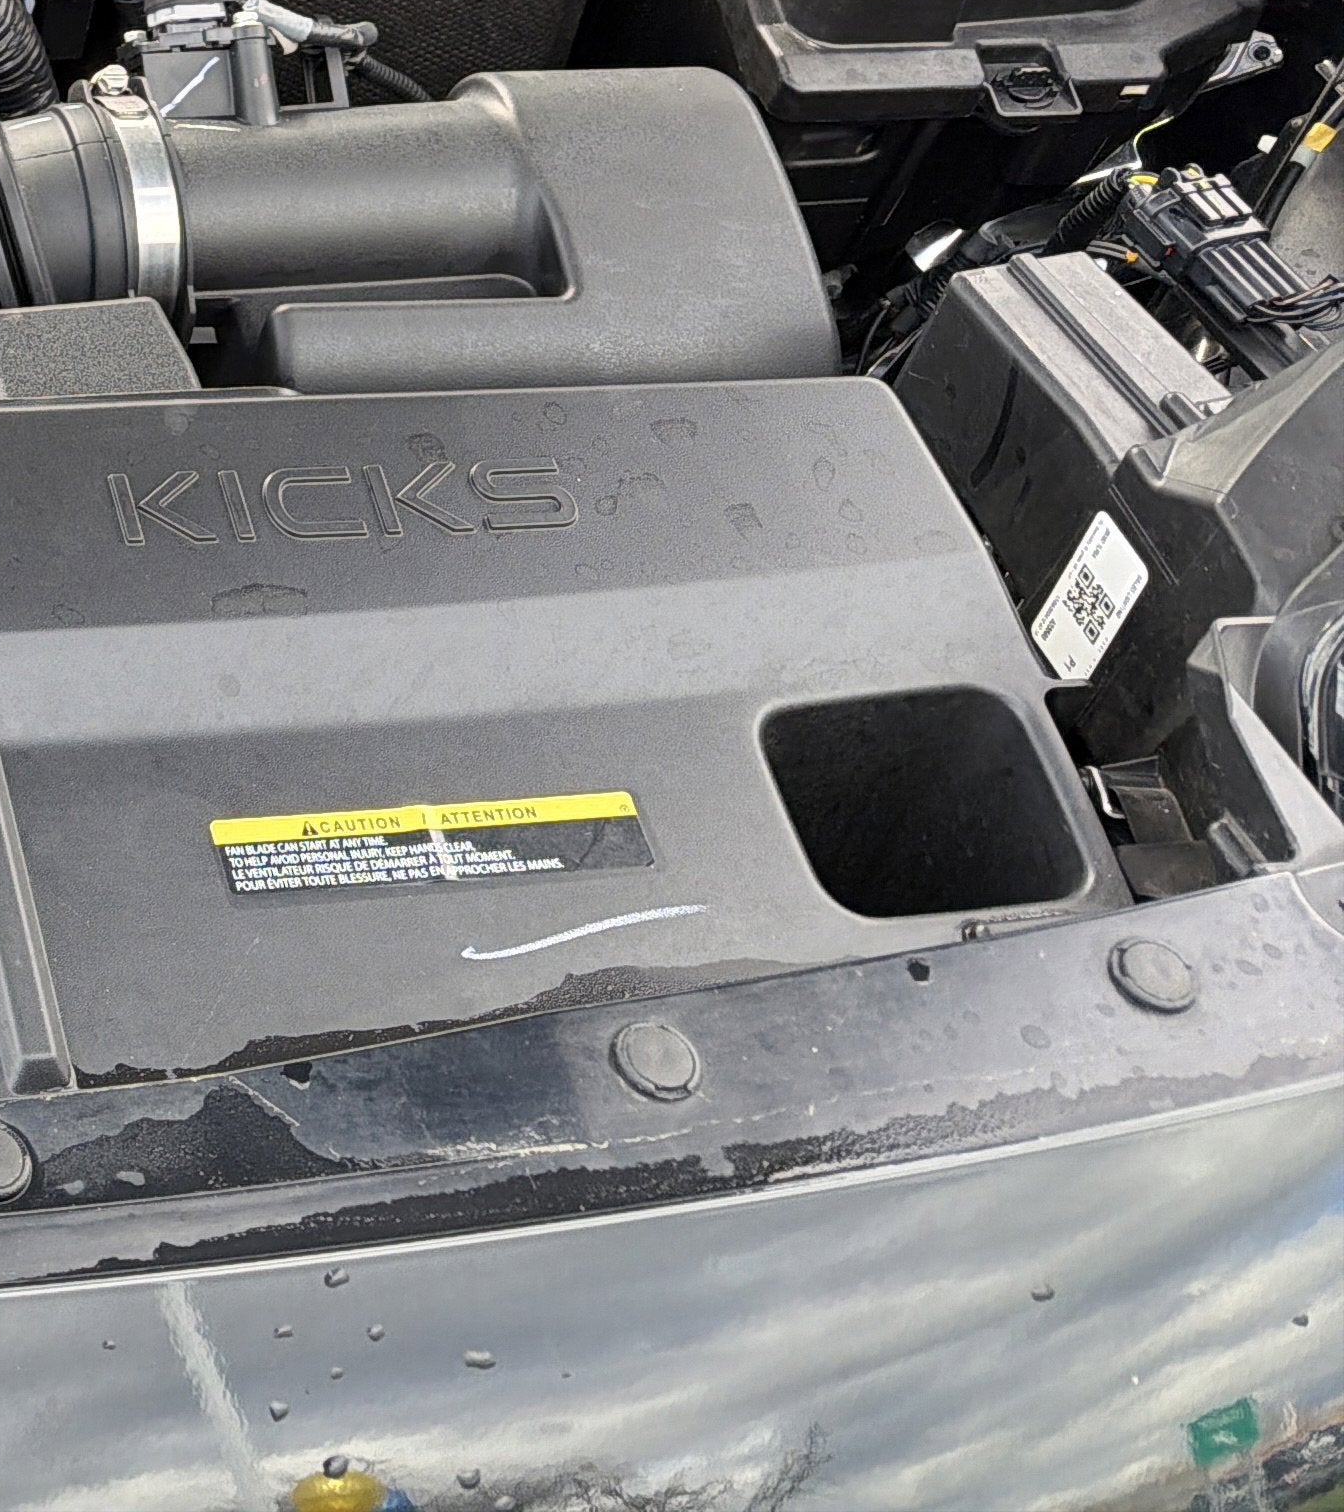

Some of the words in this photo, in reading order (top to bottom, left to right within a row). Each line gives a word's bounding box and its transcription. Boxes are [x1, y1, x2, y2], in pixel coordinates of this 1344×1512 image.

[107, 456, 580, 547] KICKS
[319, 816, 401, 833] CAUTION
[441, 806, 537, 825] ATTENTION
[225, 846, 245, 856] FAN
[245, 843, 277, 856] BLADE
[279, 842, 298, 853] CAN
[300, 840, 326, 852] START
[330, 839, 340, 849] AT
[343, 838, 361, 848] ANY
[228, 857, 243, 868] TO
[245, 856, 268, 867] HELP
[271, 853, 299, 865] AVOID
[301, 849, 350, 864] PERSONAL
[386, 846, 408, 857] KEEP
[232, 868, 246, 880] LE
[247, 864, 315, 879] VENTILATEUR
[316, 861, 352, 874] RISQUE
[355, 861, 369, 871] DE
[235, 880, 266, 892] POUR
[303, 875, 338, 888] TOUTE
[392, 869, 408, 880] NE
[410, 868, 428, 879] PAS
[509, 861, 527, 872] LES
